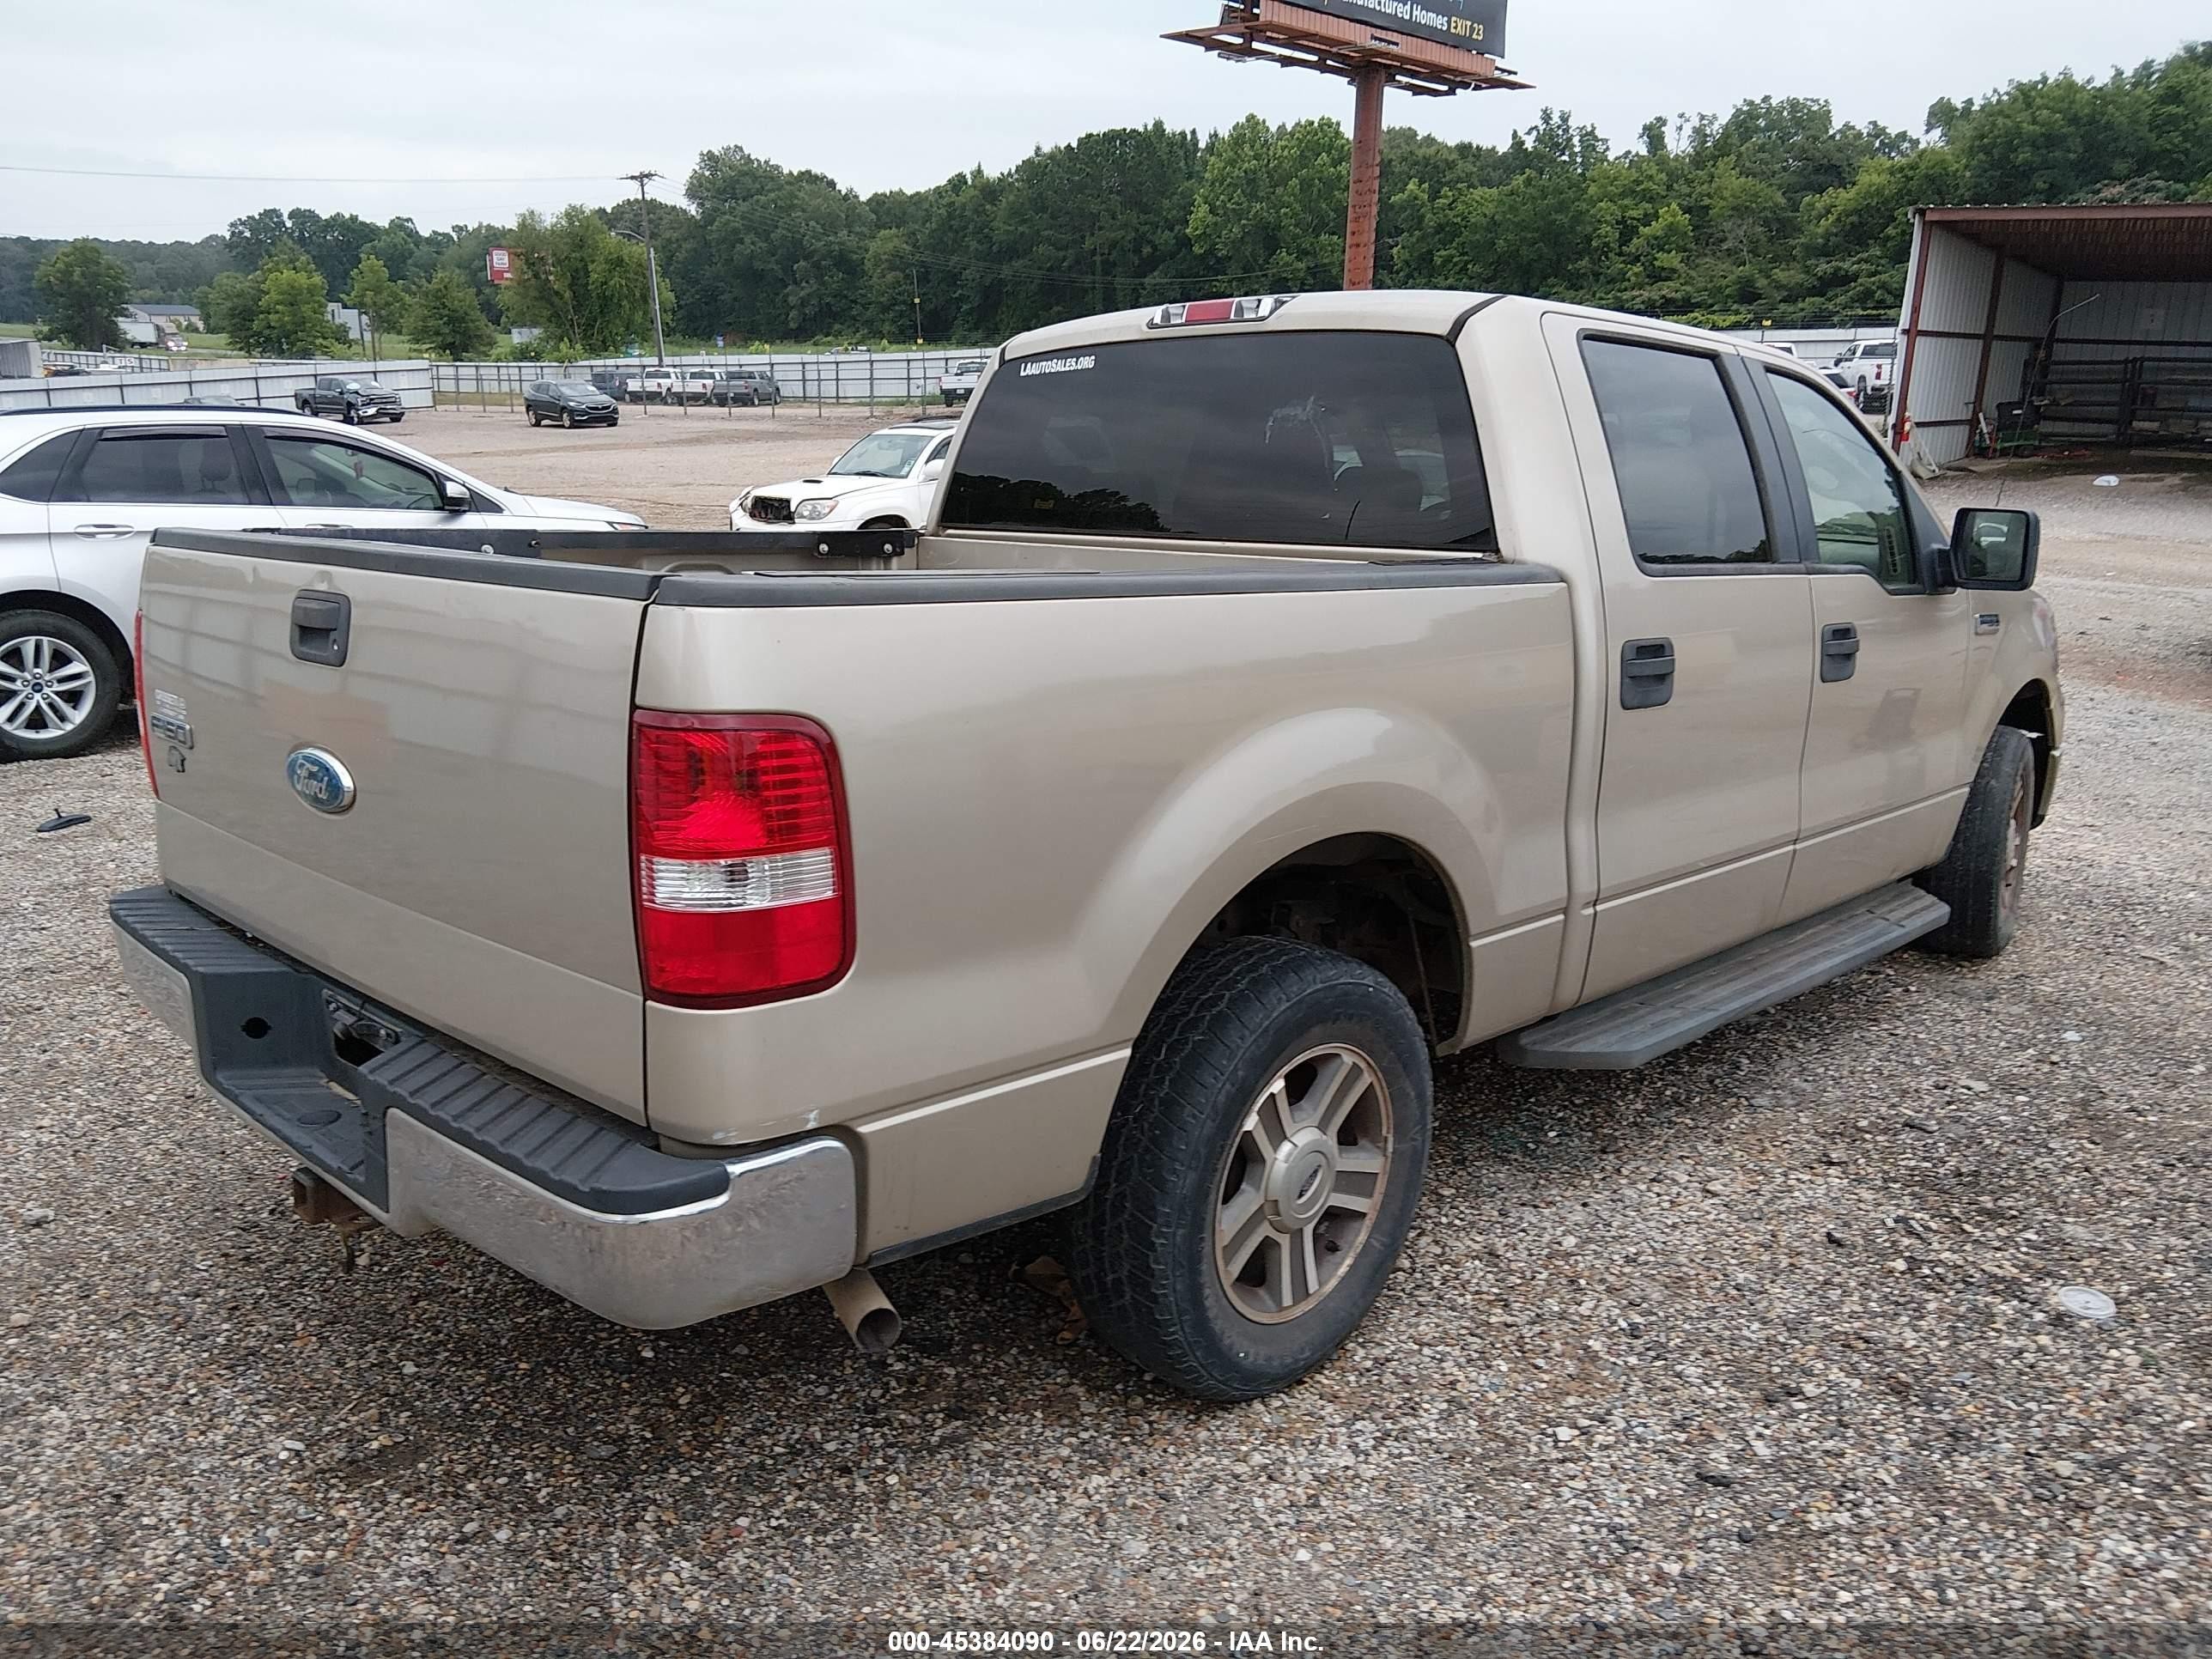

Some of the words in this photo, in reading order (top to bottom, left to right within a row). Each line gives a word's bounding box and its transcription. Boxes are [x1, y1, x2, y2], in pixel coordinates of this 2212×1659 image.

[1412, 3, 1449, 31] Homes
[1450, 16, 1472, 37] EXIT
[1472, 23, 1484, 41] 23
[294, 759, 329, 799] Ford
